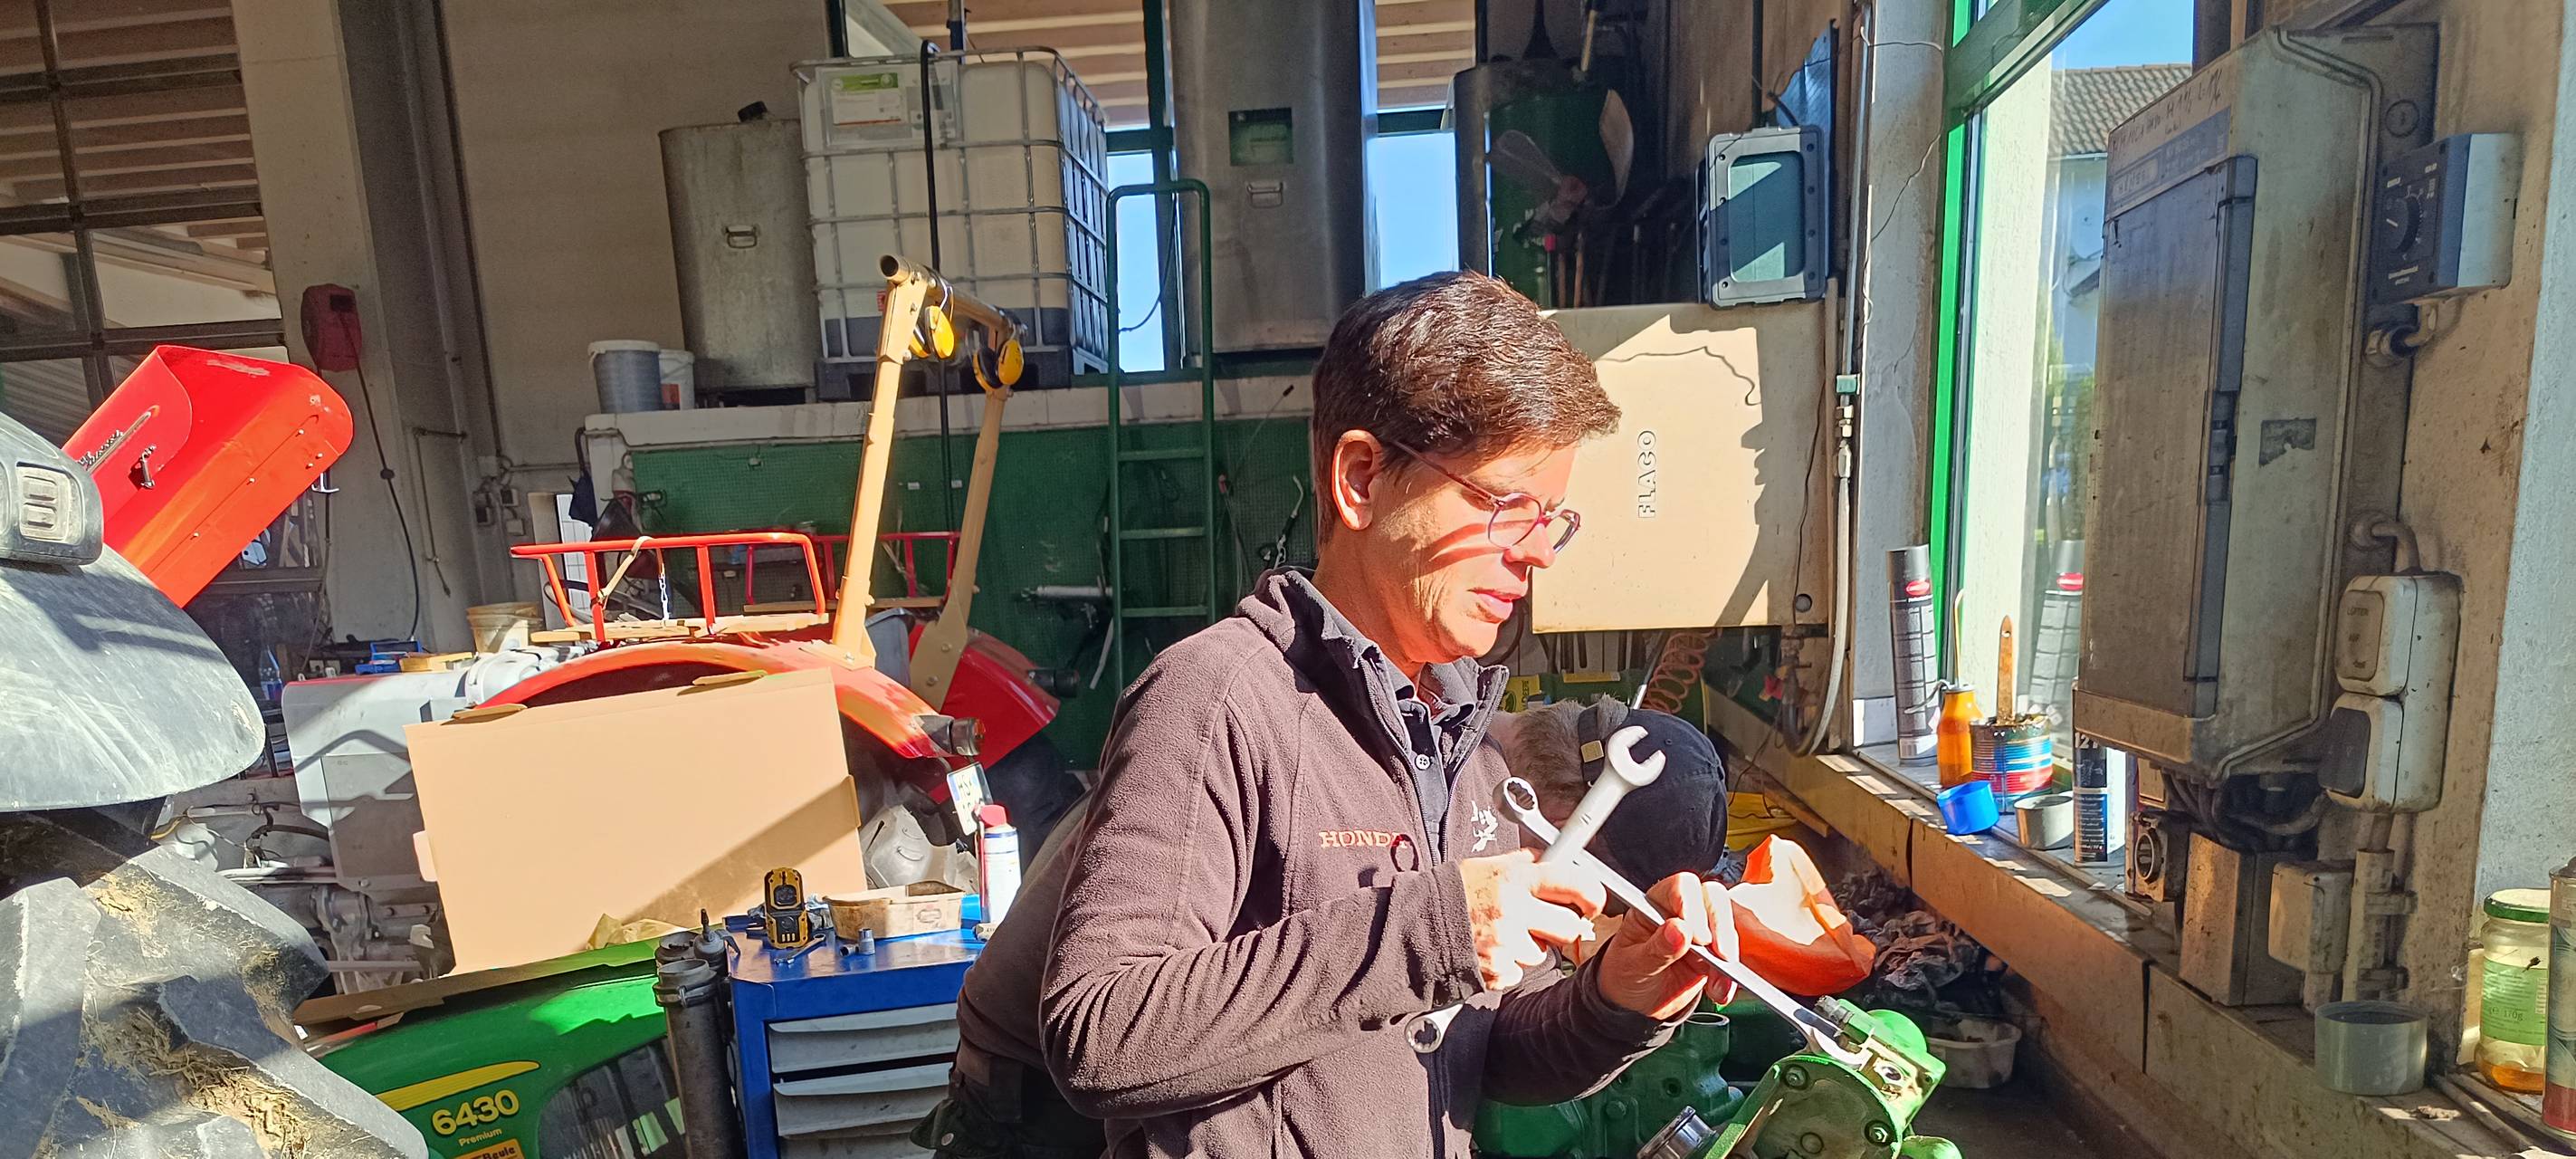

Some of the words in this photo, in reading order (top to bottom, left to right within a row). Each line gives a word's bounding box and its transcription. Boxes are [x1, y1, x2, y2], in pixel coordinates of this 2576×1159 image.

[1637, 430, 1656, 518] FLACO
[432, 1089, 520, 1135] 6430
[458, 1128, 502, 1147] Premium
